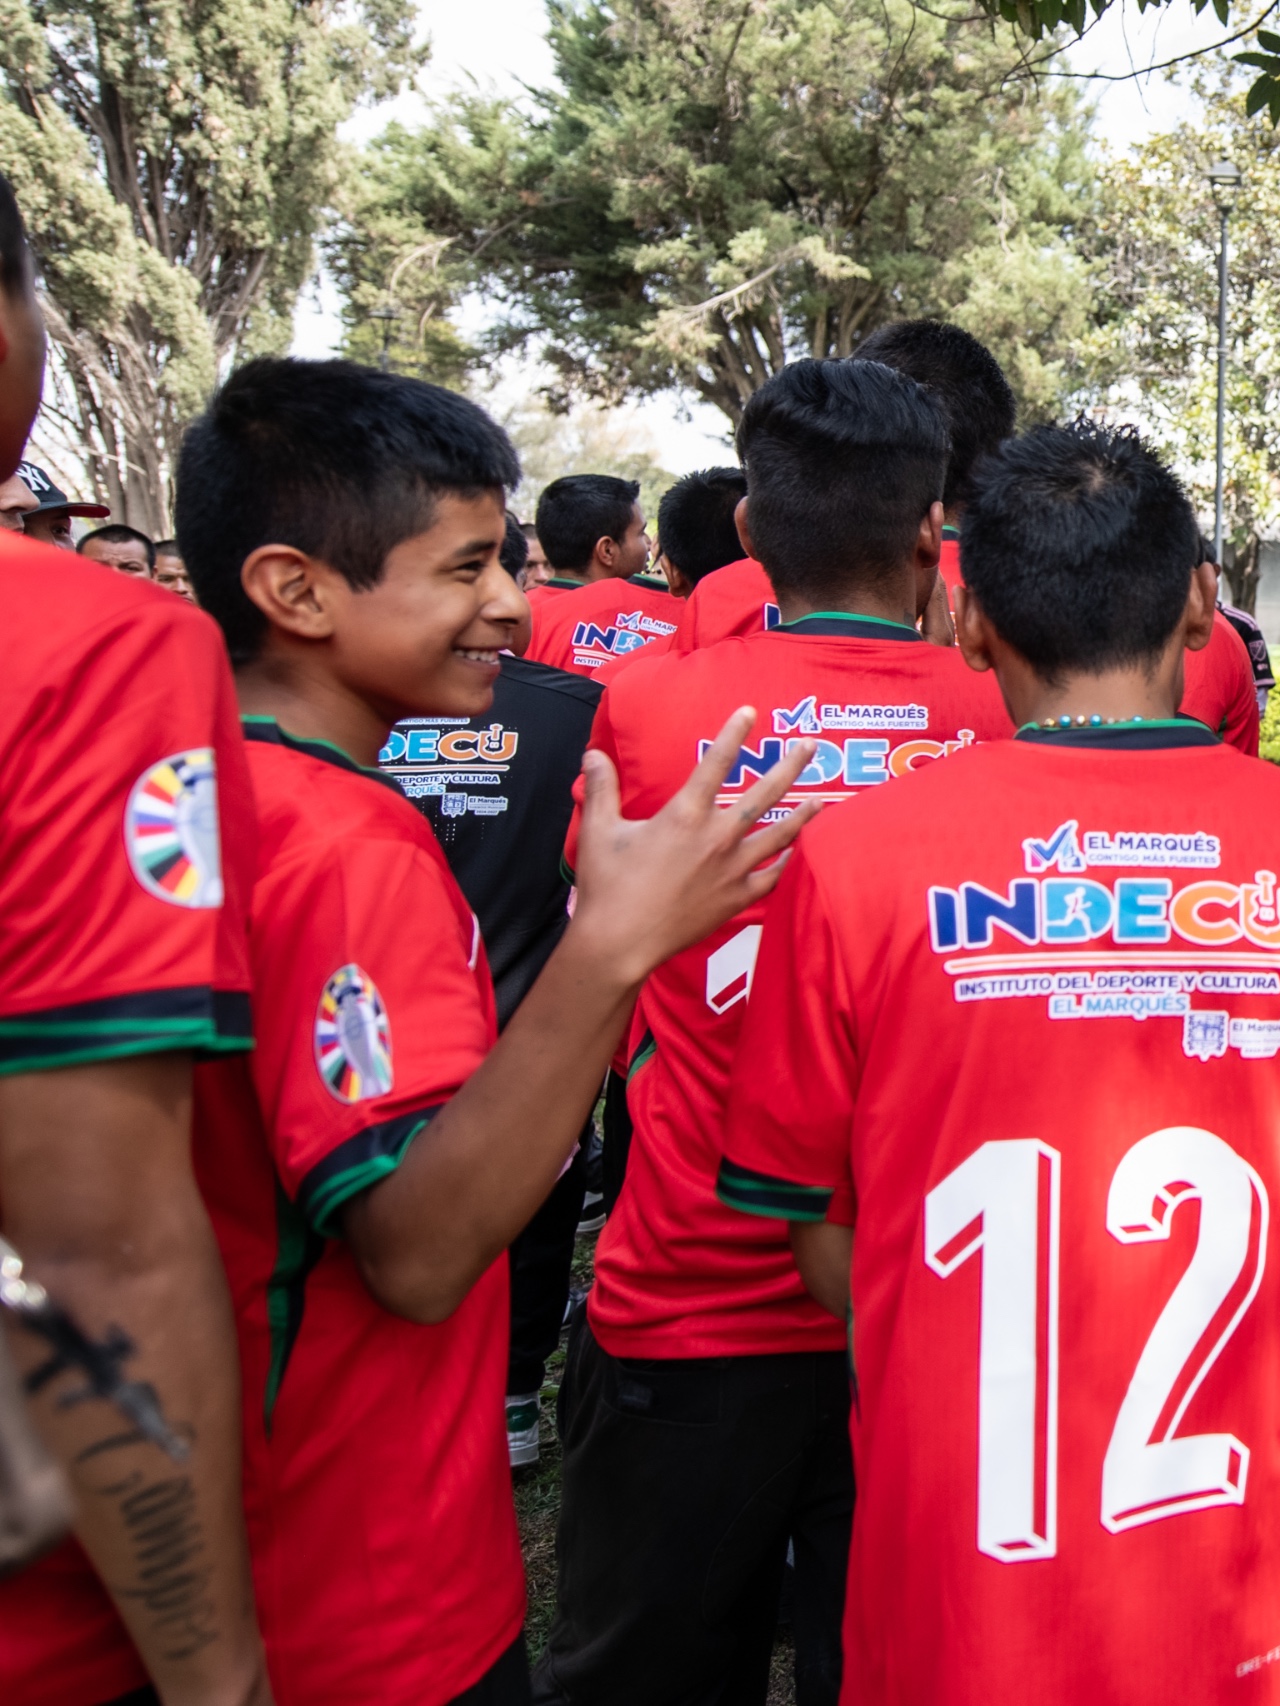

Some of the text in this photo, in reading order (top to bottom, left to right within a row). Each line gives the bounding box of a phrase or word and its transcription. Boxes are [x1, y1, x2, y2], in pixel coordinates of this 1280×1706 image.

[823, 705, 926, 719] EL MARQUÉS
[866, 719, 885, 727] MÁS
[442, 774, 451, 783] Y
[452, 774, 500, 784] CULTURA
[1088, 834, 1217, 852] EL MARQUÉS
[1088, 852, 1217, 864] CONTIGO MÁS FUERTES
[959, 974, 1278, 996] INSTITUTO DEL DEPORTE Y CULTURA
[1053, 994, 1187, 1016] EL MARQUÉS
[925, 1126, 1269, 1564] 12
